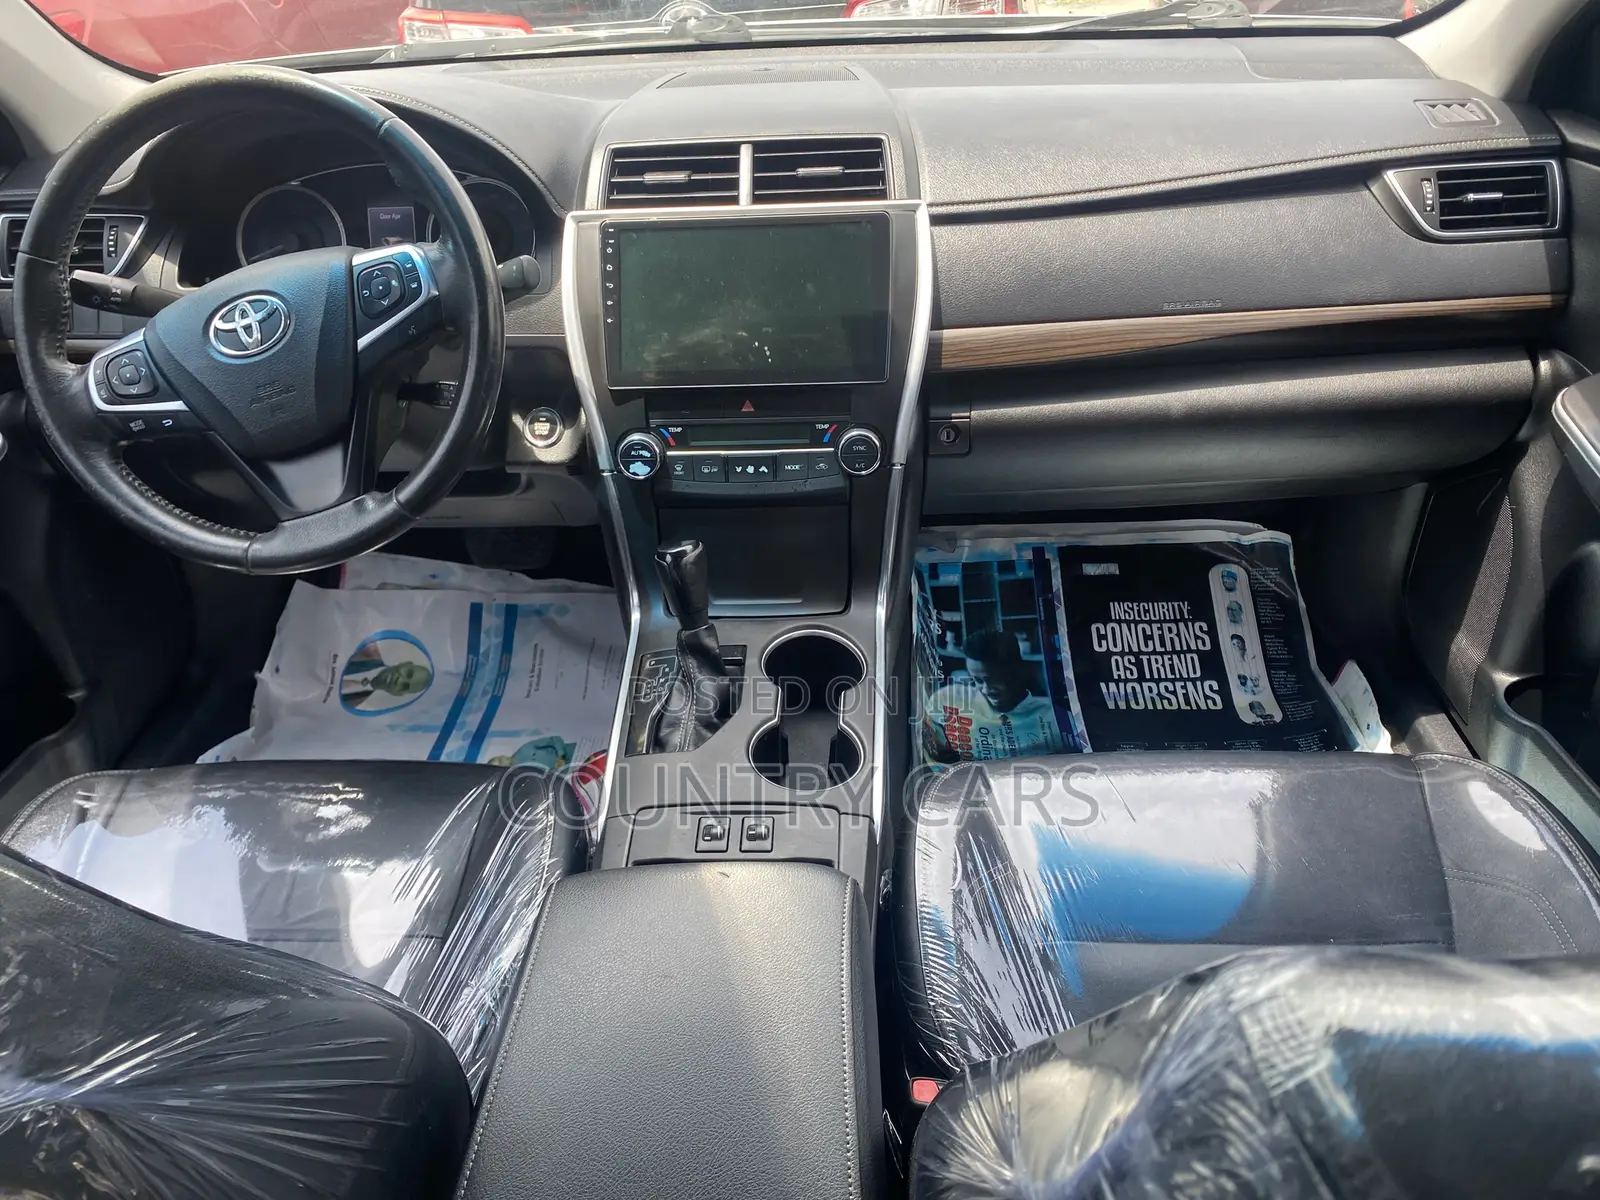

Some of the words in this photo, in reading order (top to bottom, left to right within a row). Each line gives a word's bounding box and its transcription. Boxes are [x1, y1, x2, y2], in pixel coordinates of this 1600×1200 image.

[1109, 601, 1193, 622] INSECURITY:
[1090, 621, 1212, 653] CONCERNS
[1110, 654, 1139, 680] AS
[1139, 653, 1202, 680] TREND
[1099, 680, 1224, 711] WORSENS
